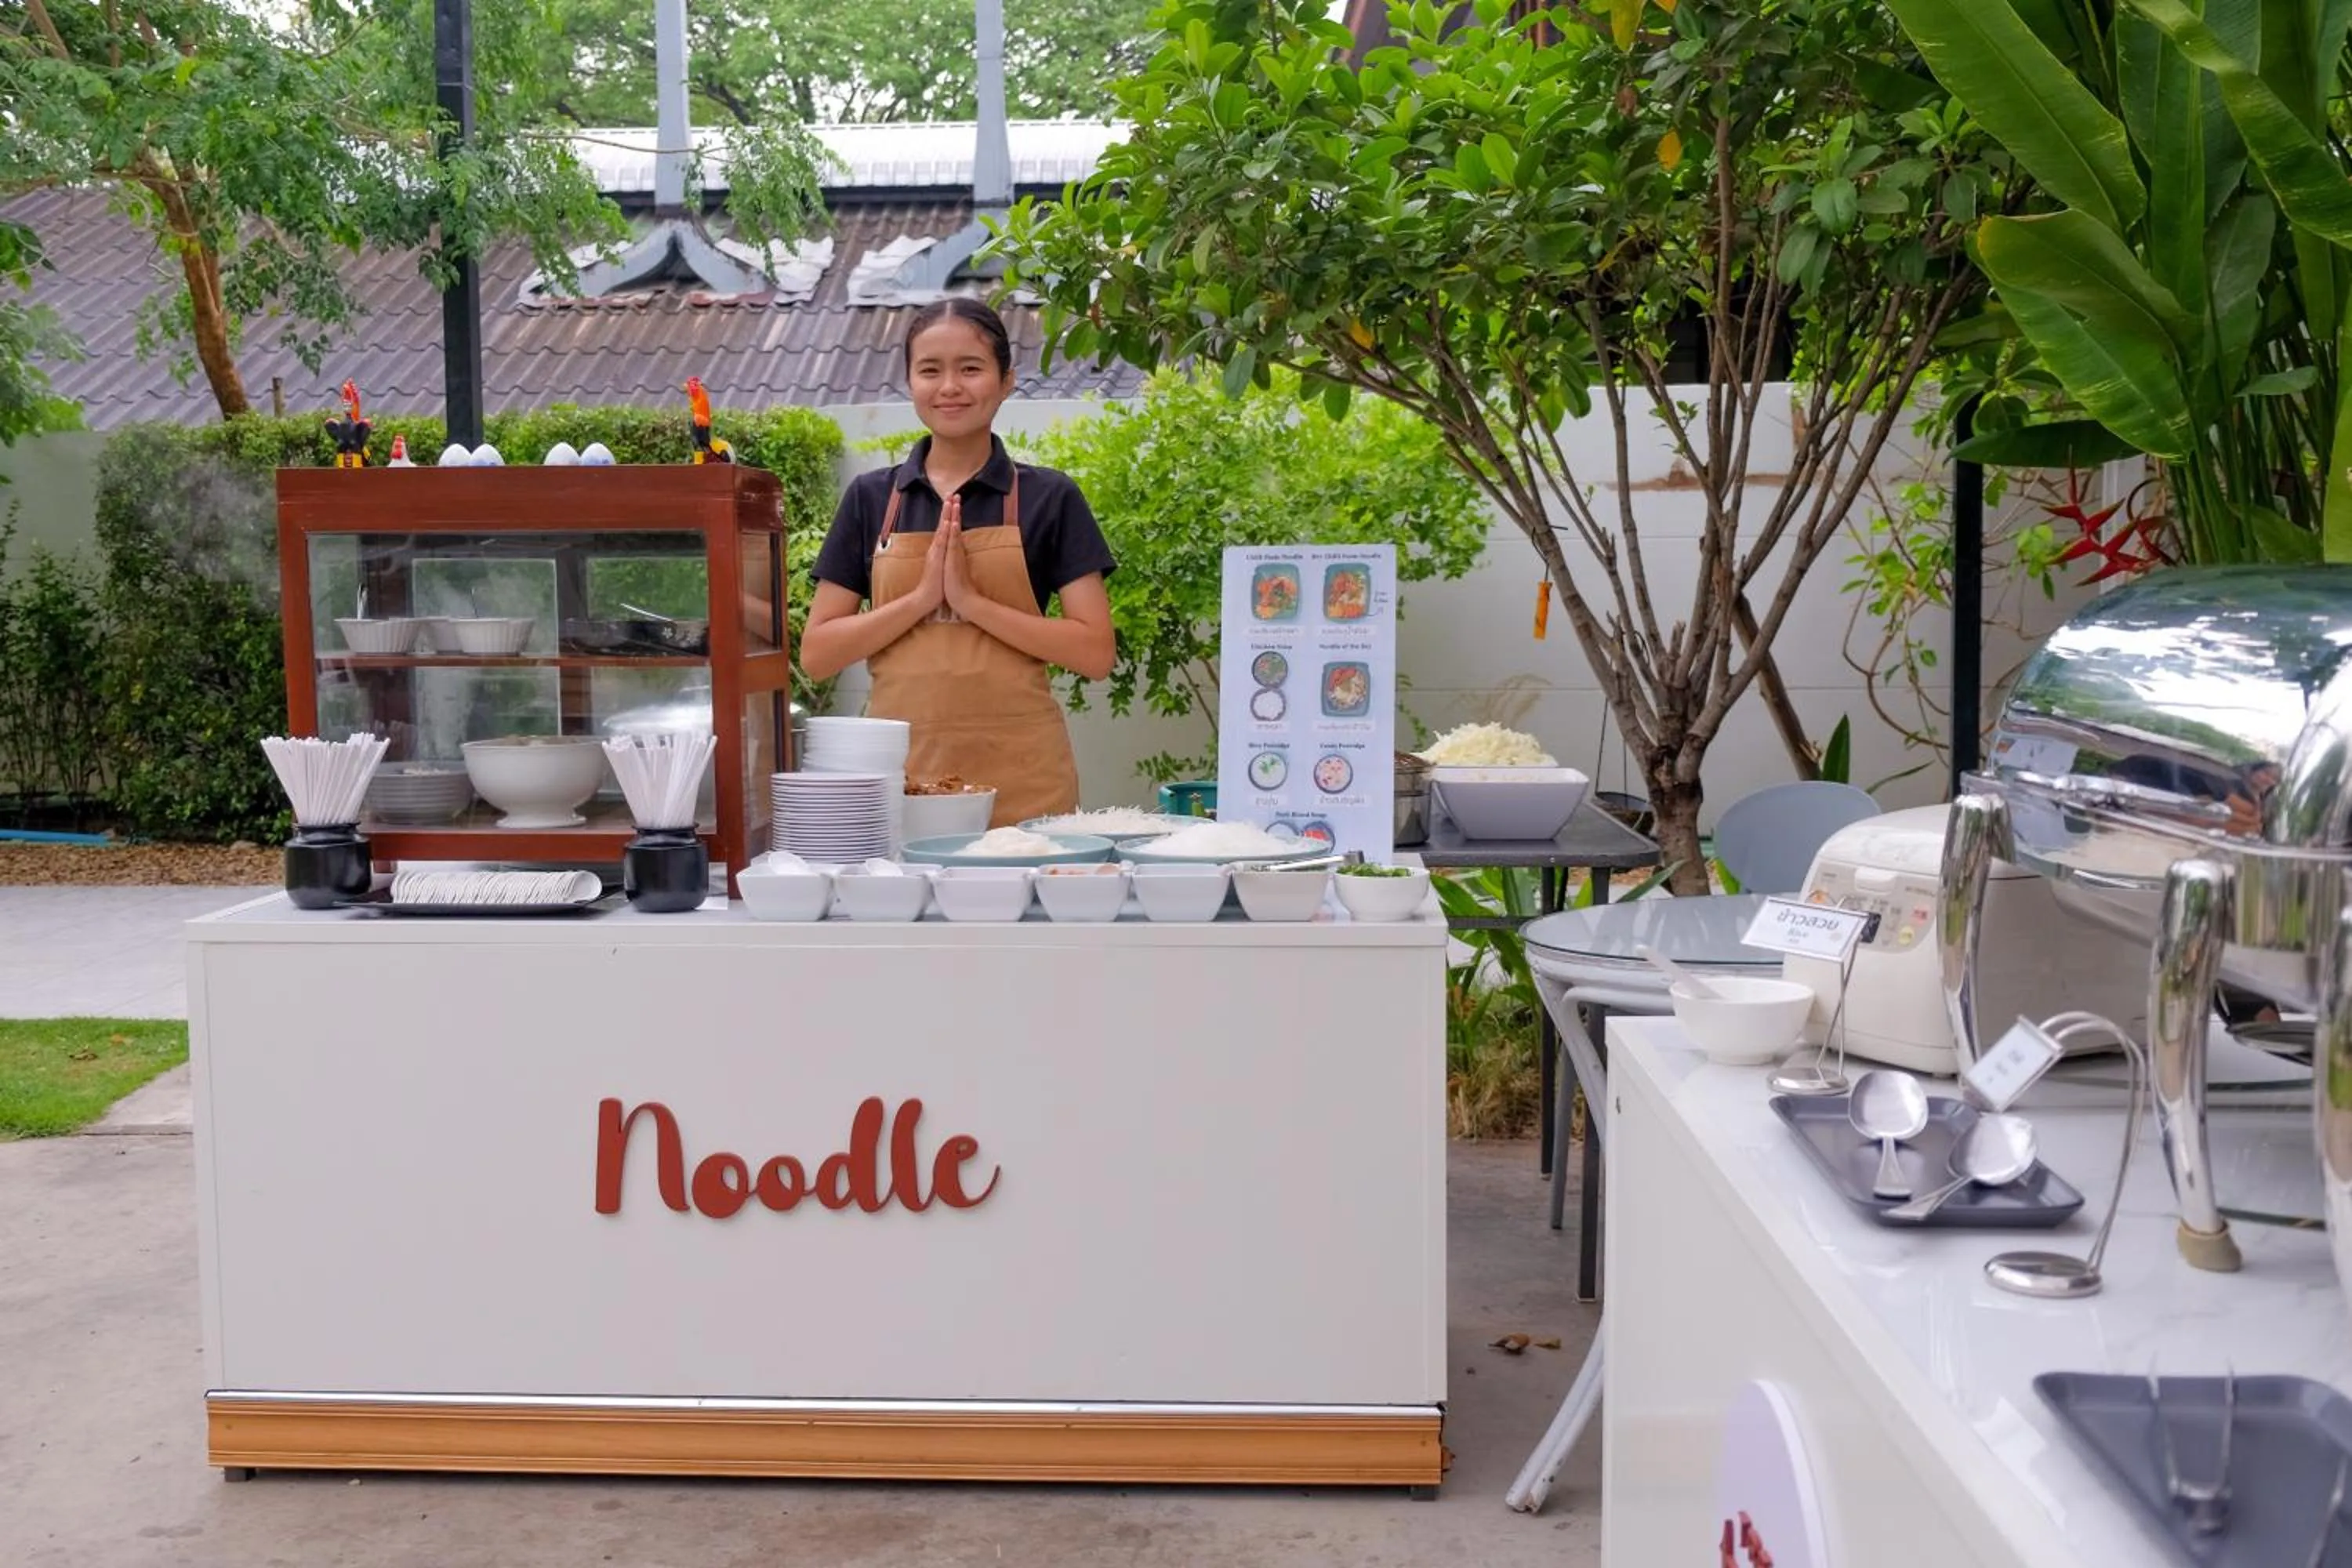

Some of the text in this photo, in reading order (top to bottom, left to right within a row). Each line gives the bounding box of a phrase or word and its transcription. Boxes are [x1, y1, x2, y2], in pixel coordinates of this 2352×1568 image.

[1776, 908, 1840, 931] ข้าวสวย
[595, 1096, 1001, 1220] Noodle
